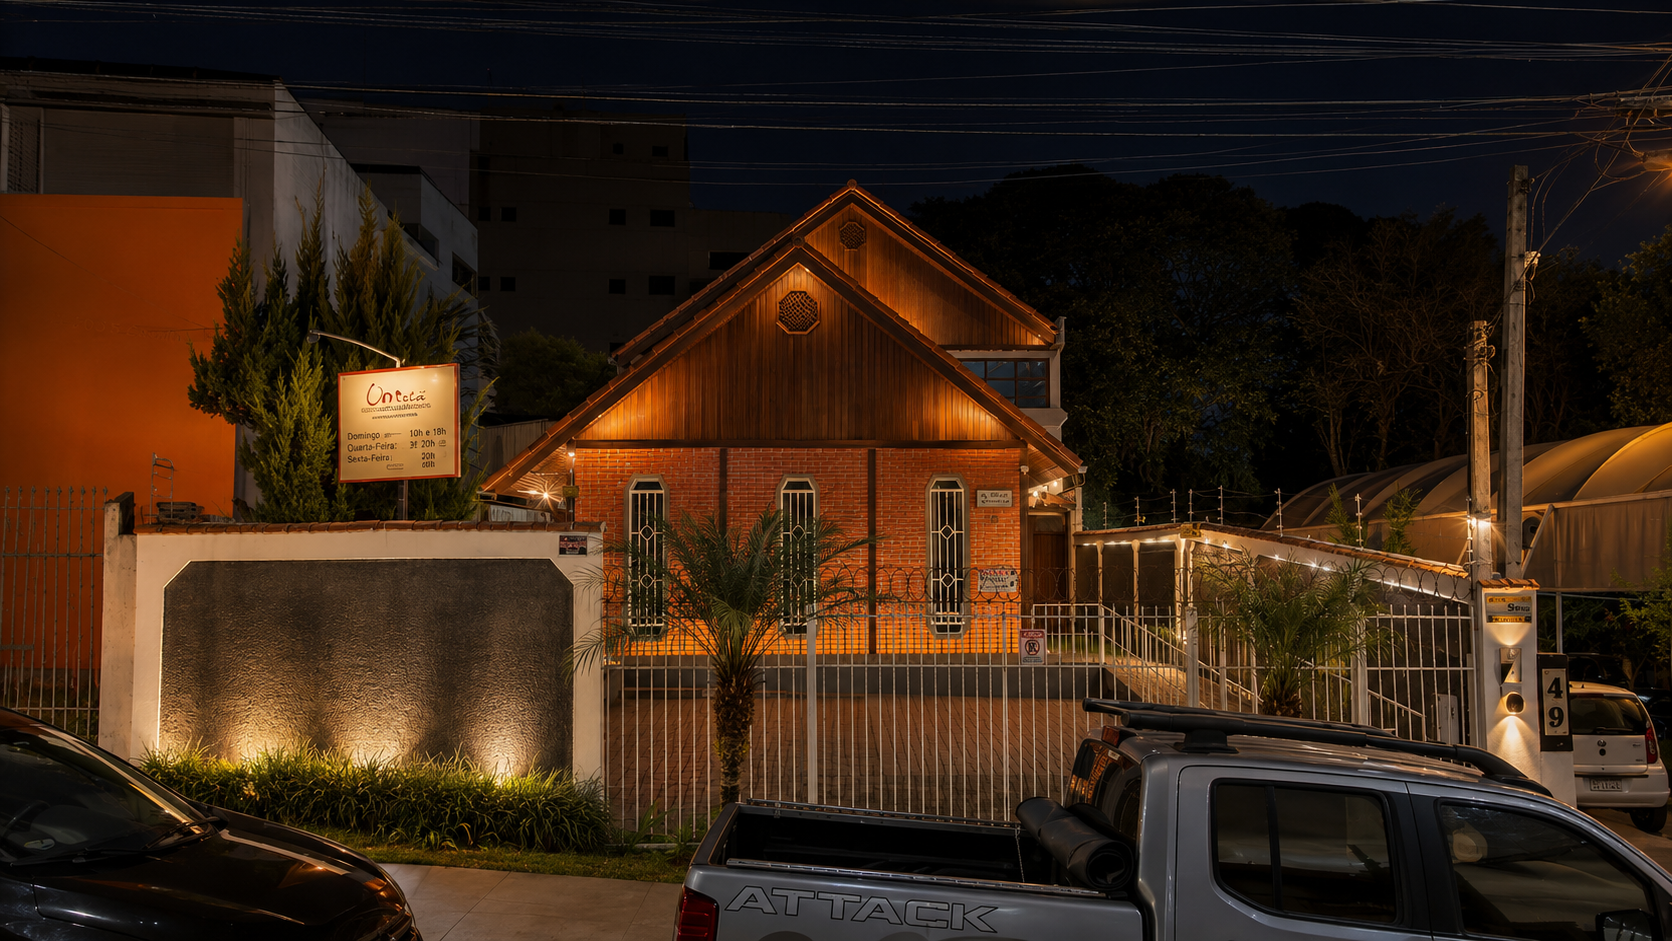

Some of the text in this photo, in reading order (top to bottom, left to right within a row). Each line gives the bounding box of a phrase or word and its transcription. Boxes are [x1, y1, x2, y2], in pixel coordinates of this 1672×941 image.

[347, 431, 381, 441] Domingo
[409, 429, 424, 437] 10h
[433, 427, 447, 436] 18h
[421, 439, 436, 448] 20h
[724, 885, 999, 934] ATTACK
